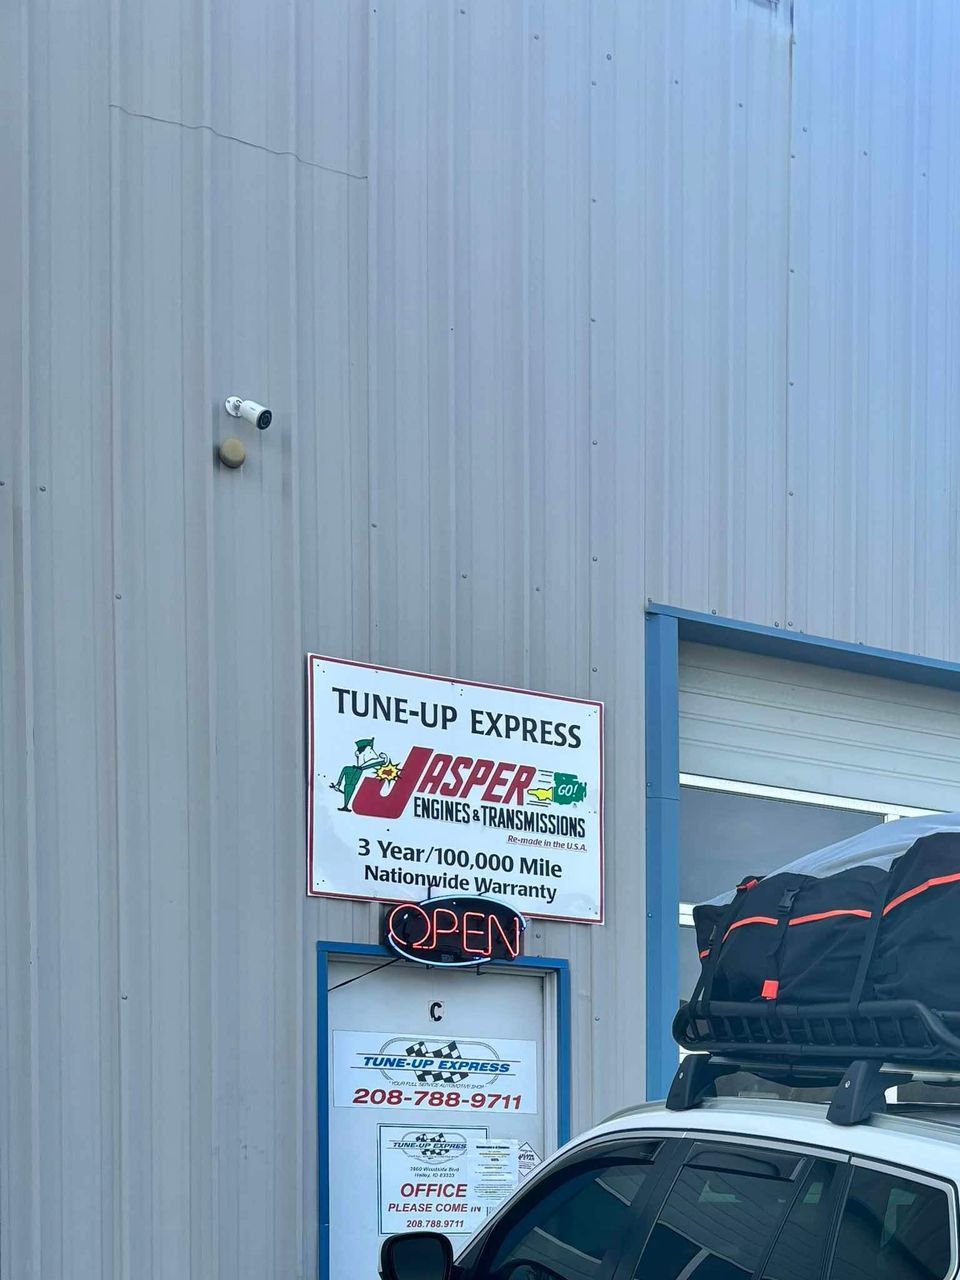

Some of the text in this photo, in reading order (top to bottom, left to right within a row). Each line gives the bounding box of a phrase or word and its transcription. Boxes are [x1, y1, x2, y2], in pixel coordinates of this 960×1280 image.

[331, 686, 582, 749] TUNE-UP EXPRESS
[351, 745, 537, 819] JASPER
[557, 783, 578, 797] GO!
[413, 796, 586, 838] ENGINES & TRANSMISSIONS
[507, 834, 543, 847] Re-made
[544, 839, 551, 847] in
[553, 840, 565, 849] the
[357, 838, 563, 878] 3 Year/100,000 Mile
[364, 864, 557, 904] Nationwide Warranty
[388, 902, 520, 958] OPEN
[429, 1001, 443, 1022] C
[363, 1056, 511, 1073] TUNE-UP EXPRESS
[352, 1088, 522, 1110] 208-788-9711
[433, 1142, 467, 1150] EXPRES
[400, 1183, 468, 1198] OFFICE
[388, 1203, 432, 1213] PLEASE
[435, 1203, 468, 1213] COME
[406, 1219, 465, 1228] 208.788.9711
